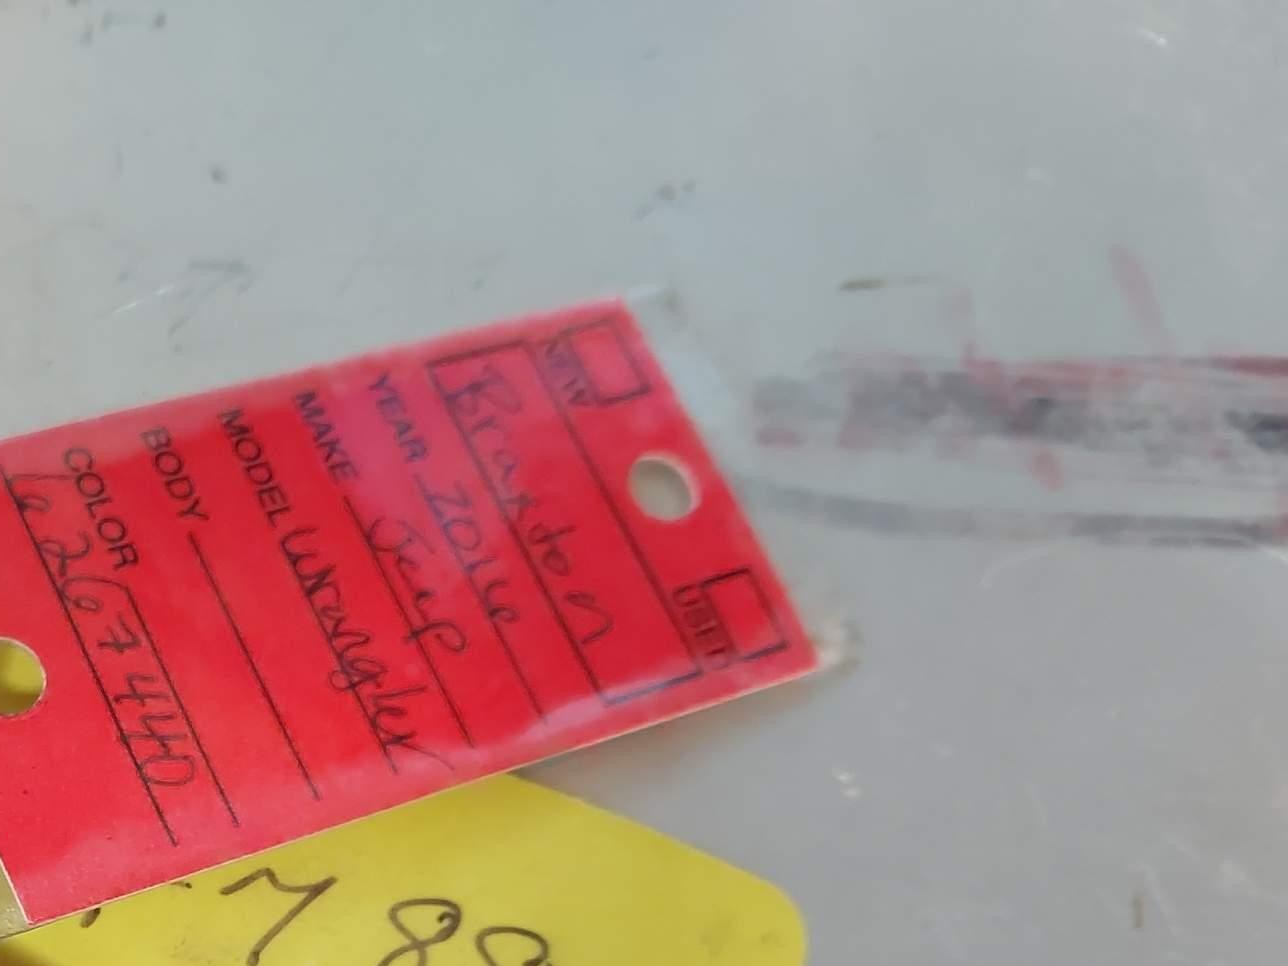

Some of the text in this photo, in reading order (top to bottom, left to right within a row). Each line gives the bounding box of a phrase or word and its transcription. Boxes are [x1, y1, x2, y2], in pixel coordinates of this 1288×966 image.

[63, 447, 139, 569] COLOR
[141, 426, 211, 522] BODY
[220, 408, 292, 528] MODEL
[294, 391, 466, 653] MAKE Jeep
[369, 373, 519, 625] YEAR 2016
[7, 472, 195, 787] 6267440
